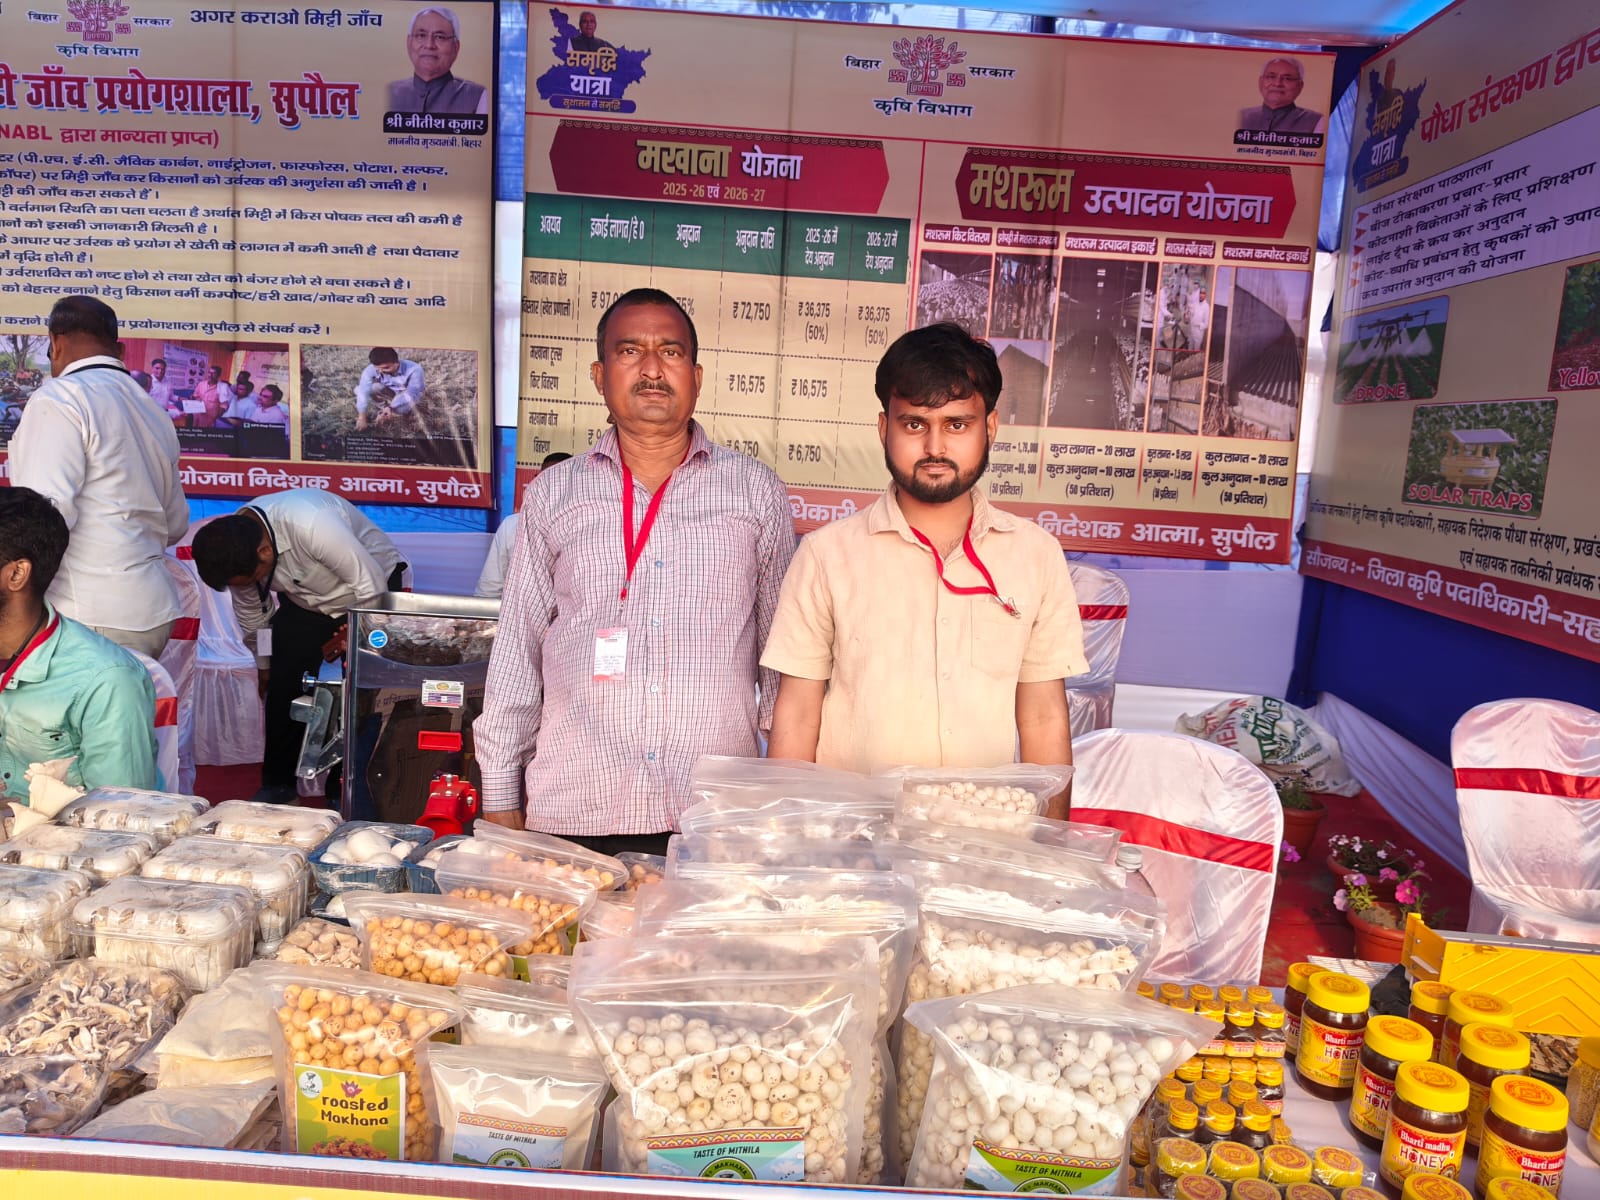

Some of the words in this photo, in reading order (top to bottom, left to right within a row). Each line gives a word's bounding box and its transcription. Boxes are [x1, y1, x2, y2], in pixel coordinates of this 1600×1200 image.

[28, 11, 59, 22] बिहार
[133, 17, 171, 26] सरकार
[190, 10, 236, 23] अगर
[240, 9, 299, 24] कराओ
[304, 9, 341, 27] मिट्टी
[347, 10, 383, 26] जाँच
[56, 44, 89, 57] कृषि
[93, 45, 139, 56] विभाग
[567, 47, 617, 75] समृद्धि
[846, 55, 881, 69] बिहार
[969, 66, 1015, 79] सरकार
[570, 74, 612, 96] यात्रा
[22, 66, 89, 110] जाँच
[93, 68, 261, 122] प्रयोगशाला,
[269, 72, 360, 128] सुपौल
[873, 97, 913, 116] कृषि
[917, 99, 973, 117] विभाग
[1420, 100, 1467, 143] पौधा
[1467, 52, 1553, 124] संरक्षण
[386, 113, 402, 128] श्री
[405, 113, 446, 129] नीतीश
[448, 117, 485, 134] कुमार
[60, 128, 97, 143] द्वारा
[99, 129, 168, 144] मान्यता
[171, 130, 219, 149] प्राप्त)
[1237, 130, 1251, 143] श्री
[1252, 131, 1287, 144] नीतीश
[1289, 134, 1320, 147] कुमार
[637, 139, 732, 178] मखाना
[742, 145, 803, 179] योजना
[1371, 134, 1398, 167] यात्रा
[663, 182, 687, 197] 2025
[707, 184, 720, 198] एवं
[723, 187, 748, 201] 2026
[969, 163, 1075, 213] मशरूम
[1083, 185, 1184, 218] उत्पादन
[1186, 182, 1274, 224] योजना
[1372, 201, 1394, 216] पौधा
[1397, 183, 1435, 206] संरक्षण
[1437, 160, 1494, 188] पाठशाला
[1416, 203, 1471, 233] विक्रेताओं
[1474, 198, 1488, 212] के
[1492, 188, 1523, 207] लिए
[1526, 161, 1597, 196] प्रशिक्षण
[9, 201, 56, 215] वर्तमान
[59, 202, 97, 215] स्थिति
[99, 205, 118, 216] का
[121, 205, 146, 218] पता
[149, 207, 186, 219] चलता
[190, 204, 200, 219] है
[244, 207, 271, 222] मिट्टी
[275, 208, 287, 221] में
[290, 208, 322, 222] किस
[324, 210, 362, 223] पोषक
[365, 213, 393, 225] तत्व
[396, 212, 415, 226] की
[418, 213, 449, 227] कमी
[452, 214, 463, 228] है
[540, 215, 562, 234] अवयव
[1370, 218, 1390, 232] बीज
[1392, 196, 1449, 225] टीकाकरण
[676, 223, 702, 248] अनुदान
[925, 229, 951, 243] मशरूम
[952, 226, 967, 243] किट
[968, 227, 991, 244] वितरण
[1413, 238, 1425, 251] के
[1427, 232, 1450, 248] क्रय
[1452, 224, 1474, 240] कर
[1476, 207, 1528, 231] अनुदान
[736, 229, 759, 254] अनुदान
[760, 227, 776, 250] राशि
[1065, 236, 1096, 251] मशरूम
[1098, 237, 1130, 253] उत्पादन
[1131, 237, 1157, 255] इकाई
[1422, 247, 1459, 267] प्रबंधन
[1461, 242, 1481, 257] हेतु
[1483, 224, 1532, 251] कृषकों
[1534, 216, 1560, 234] को
[1223, 246, 1253, 260] मशरूम
[1286, 248, 1310, 264] इकाई
[1413, 268, 1456, 288] अनुदान
[1457, 259, 1477, 275] की
[1480, 249, 1527, 269] योजना
[805, 321, 829, 344] (50%)
[865, 325, 889, 349] (50%)
[1356, 384, 1406, 401] DRONE
[1050, 443, 1068, 458] कुल
[1069, 444, 1095, 456] लागत
[1114, 446, 1136, 458] लाख
[1046, 463, 1064, 479] कुल
[1065, 464, 1098, 480] अनुदान
[1114, 467, 1136, 478] लाख
[180, 467, 243, 488] योजना
[249, 466, 331, 491] निदेशक
[340, 474, 410, 496] आत्मा,
[416, 468, 481, 502] सुपौल
[1080, 482, 1114, 501] प्रतिशत)
[1408, 483, 1463, 505] SOLAR
[1469, 489, 1532, 512] TRAPS
[1037, 509, 1124, 540] निदेशक
[1130, 522, 1205, 547] आत्मा,
[1211, 523, 1279, 556] सुपौल
[1437, 517, 1467, 537] सहायक
[1468, 518, 1503, 543] निदेशक
[1504, 522, 1527, 545] पौधा
[1529, 528, 1570, 556] संरक्षण,
[1306, 546, 1350, 573] सौजन्य
[1367, 557, 1406, 587] जिला
[1407, 570, 1443, 600] कृषि
[1459, 548, 1474, 568] एवं
[1475, 553, 1509, 573] सहायक
[1510, 558, 1553, 583] तकनिकी
[1555, 566, 1595, 592] प्रबंधक
[1325, 1033, 1346, 1045] Bharti
[1365, 1076, 1387, 1095] Bharti
[322, 1097, 388, 1111] roasted
[1364, 1090, 1391, 1111] HON
[321, 1110, 388, 1126] Makhana
[488, 1131, 504, 1140] TASTE
[513, 1135, 537, 1144] MITHILA
[1400, 1130, 1424, 1149] Bharti
[1424, 1141, 1451, 1153] madhu
[693, 1149, 715, 1158] TASTE
[717, 1147, 727, 1156] OF
[728, 1146, 760, 1155] MITHILA
[1400, 1145, 1446, 1170] HONEY
[1015, 1164, 1037, 1174] TASTE
[1038, 1167, 1048, 1175] OF
[1049, 1168, 1082, 1178] MITHILA
[1521, 1157, 1548, 1170] Bharti
